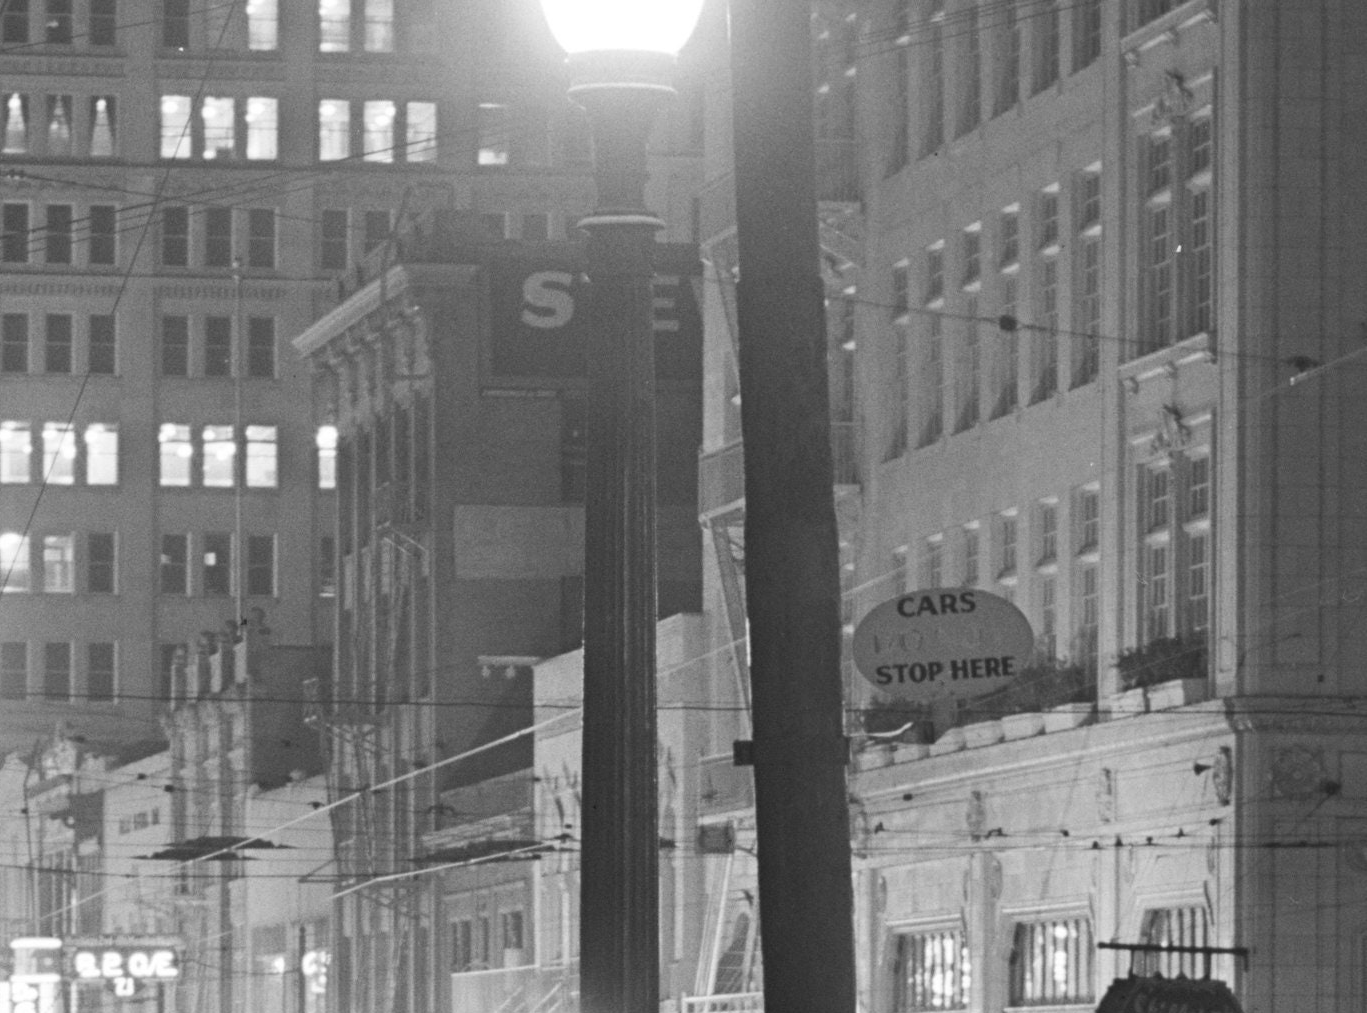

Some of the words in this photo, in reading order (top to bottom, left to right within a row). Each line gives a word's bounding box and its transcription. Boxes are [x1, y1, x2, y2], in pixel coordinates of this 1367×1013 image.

[896, 592, 977, 618] CARS
[875, 661, 943, 686] STOP
[949, 656, 1017, 681] HERE
